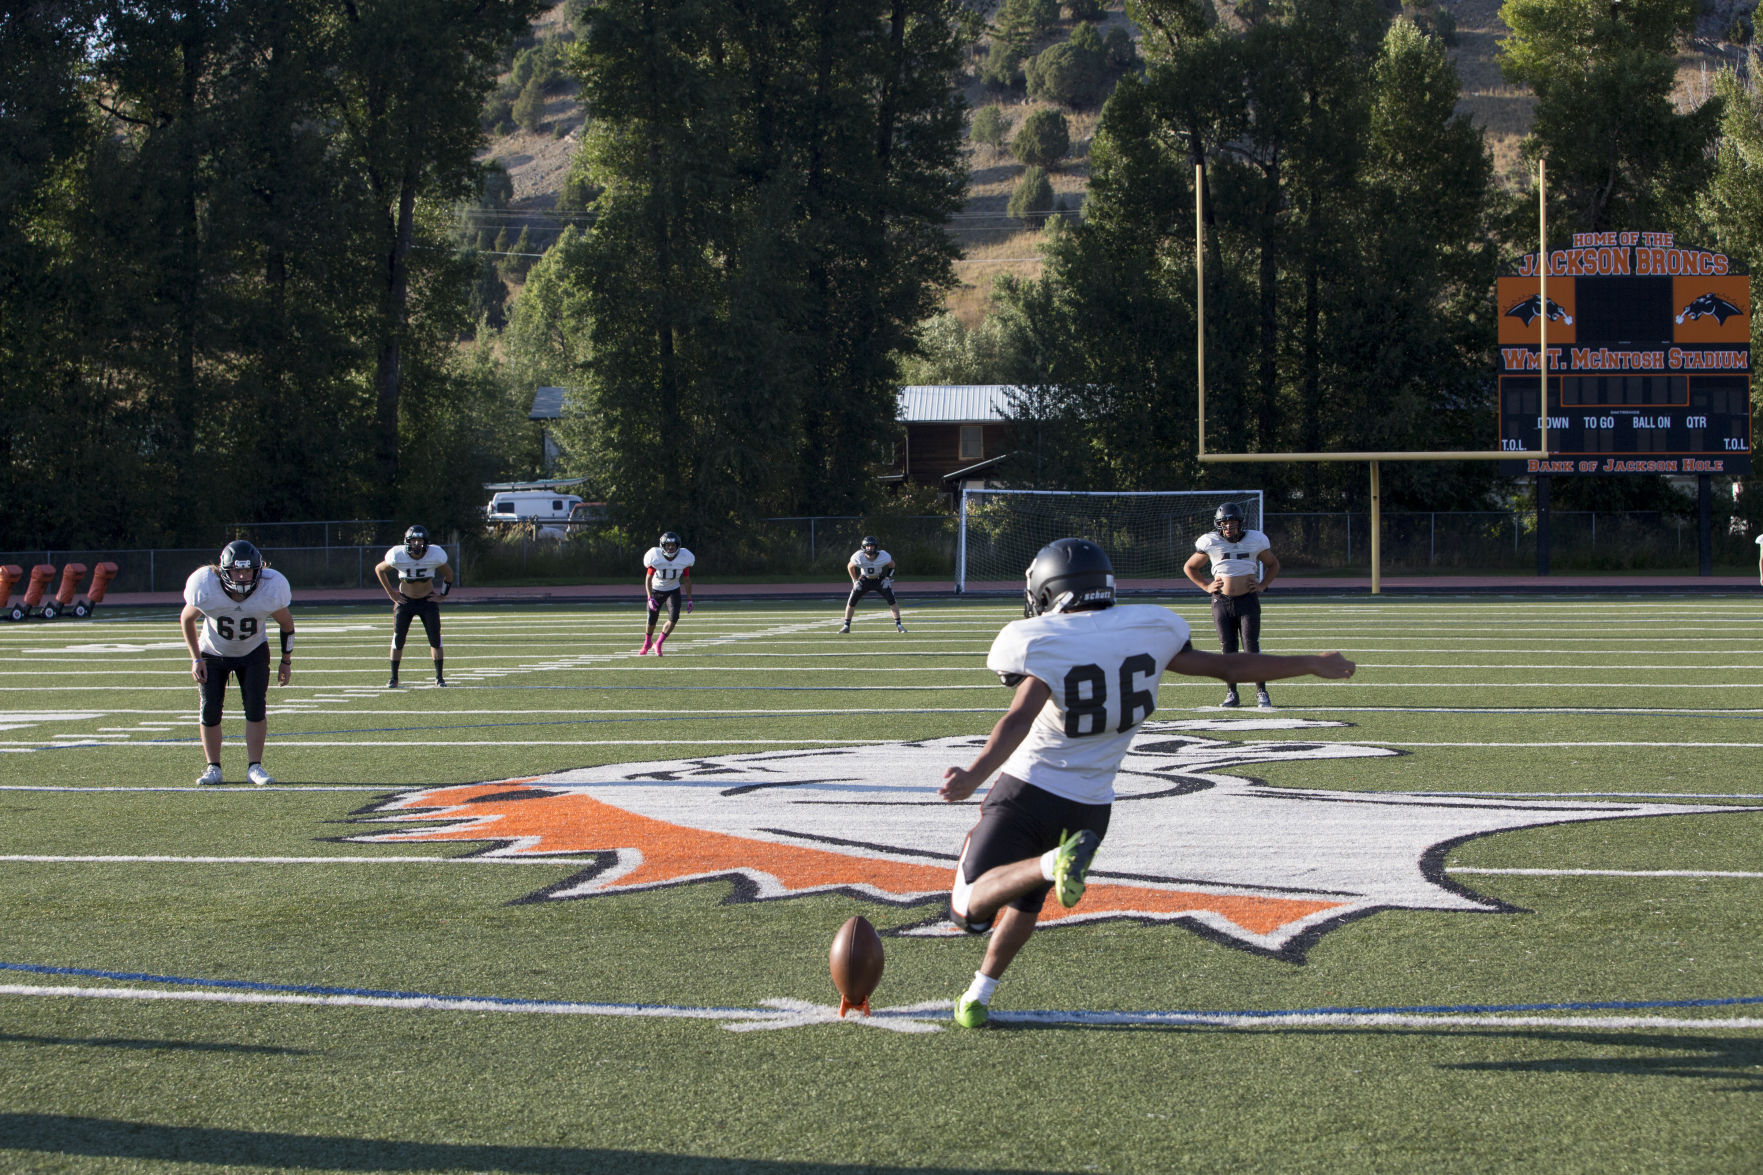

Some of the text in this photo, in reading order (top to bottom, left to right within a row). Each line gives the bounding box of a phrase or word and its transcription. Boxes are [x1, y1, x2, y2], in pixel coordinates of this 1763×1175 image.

[1573, 232, 1673, 247] HOME OF THE
[1519, 247, 1728, 276] JACKSON BRONCS
[1668, 348, 1748, 369] STADIUM
[1537, 416, 1569, 429] DOWN
[1584, 416, 1614, 428] TO GO
[1633, 416, 1671, 428] BALL ON
[1686, 416, 1707, 428] QTR
[1527, 458, 1724, 472] BANK OF JACKSON HOLE
[662, 568, 677, 580] 11
[217, 616, 258, 641] 69
[1063, 652, 1157, 738] 86
